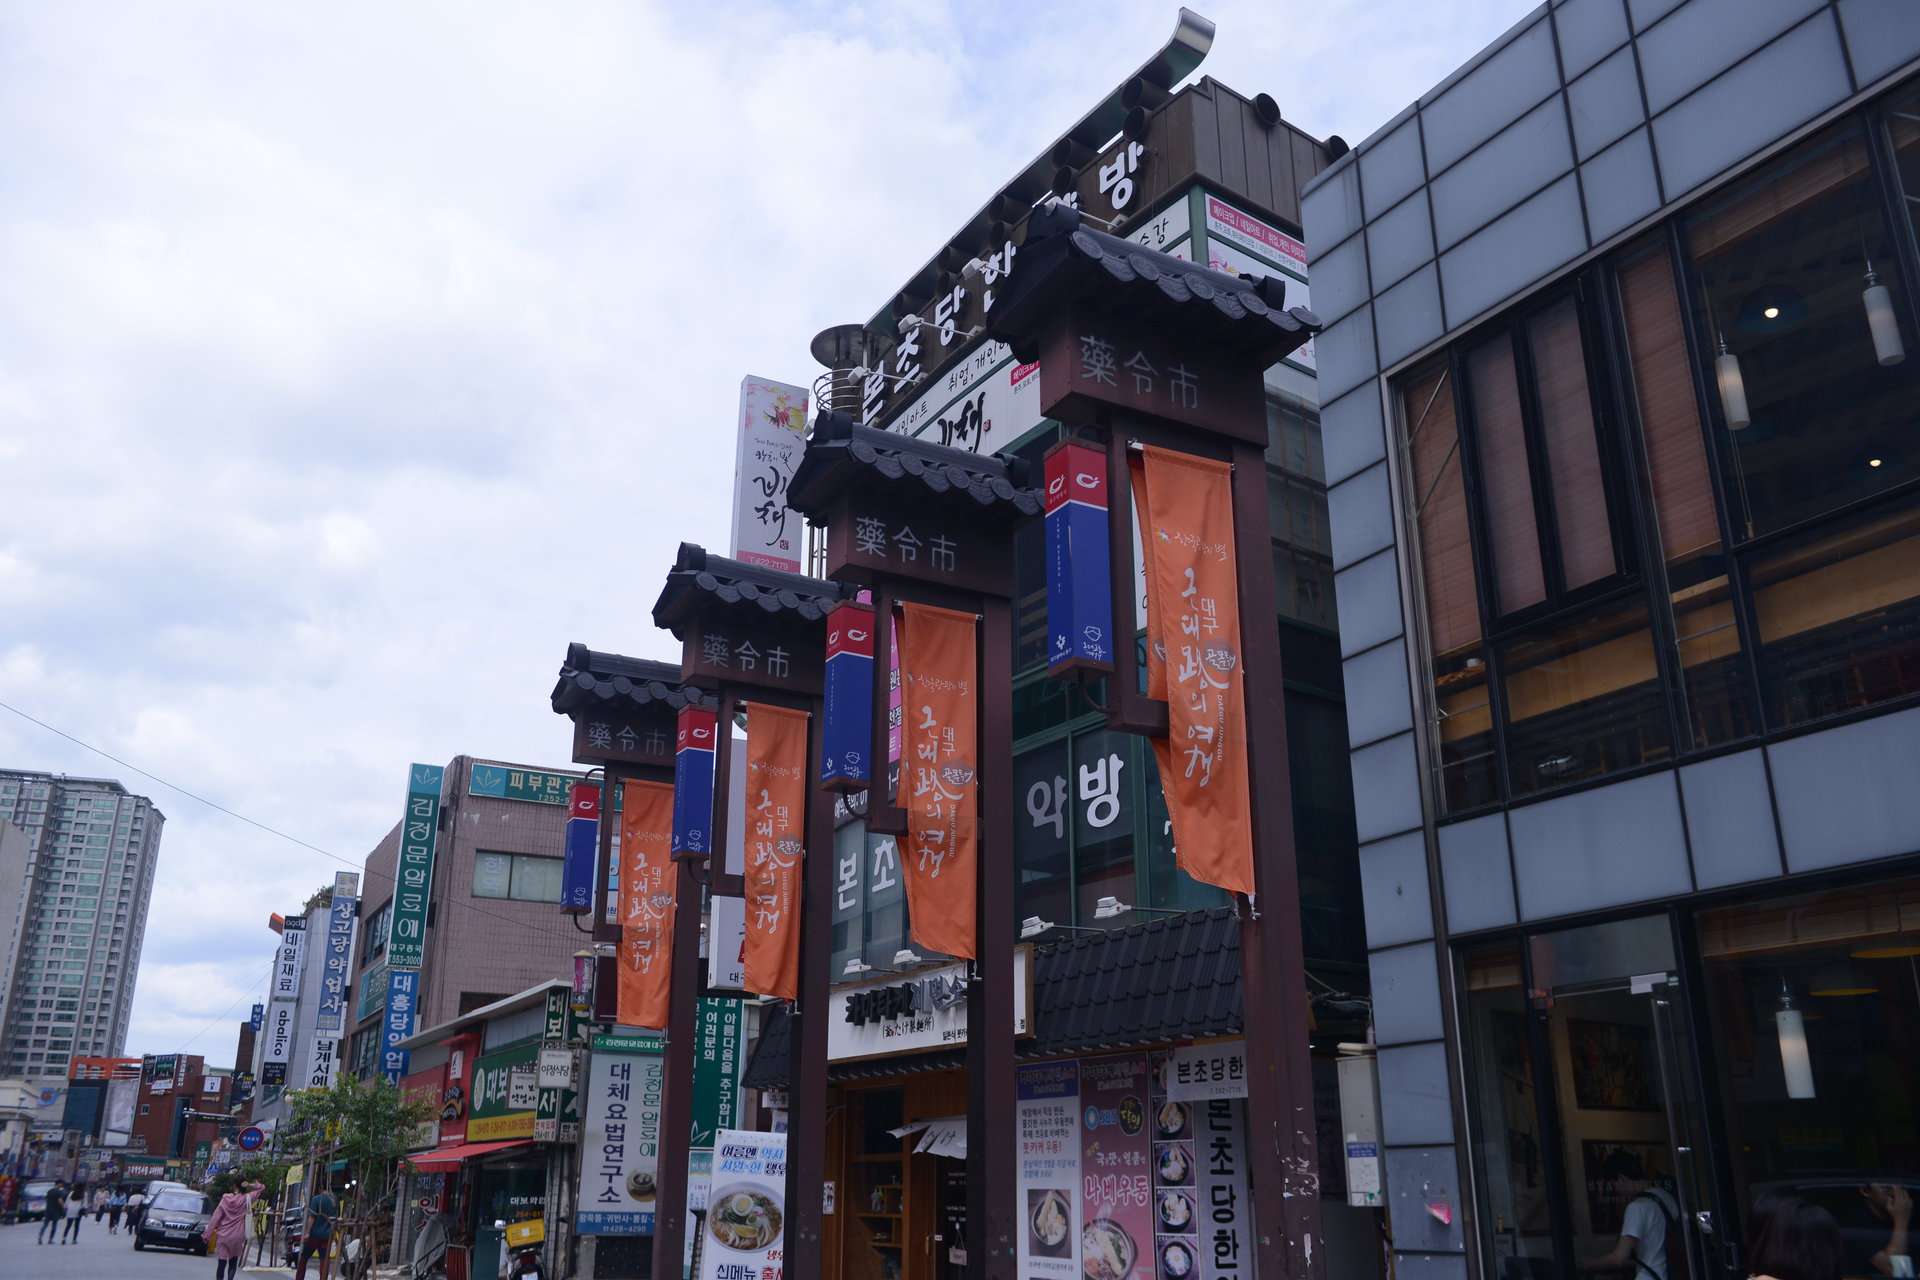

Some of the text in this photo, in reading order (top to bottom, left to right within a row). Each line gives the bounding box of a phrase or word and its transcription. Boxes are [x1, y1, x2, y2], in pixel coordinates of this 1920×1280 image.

[862, 141, 1145, 426] 본초당한방
[1080, 335, 1199, 409] 藥令市
[856, 516, 957, 572] 藥令市
[1201, 597, 1219, 635] 대구
[701, 636, 791, 679] 藥令市
[588, 721, 667, 756] 藥令市
[942, 726, 956, 757] 대구
[1216, 694, 1226, 762] DAEGU JUNGGU
[777, 805, 790, 832] 대구
[651, 866, 662, 889] 대구
[837, 839, 896, 911] 본초
[279, 932, 299, 993] 네일재료
[322, 902, 354, 1013] 상고당약업사
[274, 1009, 290, 1056] abalico
[704, 1012, 718, 1061] 여러분의
[541, 1064, 570, 1077] 이정식당
[718, 1013, 736, 1130] 아름다움을 추구합니
[1178, 1056, 1243, 1084] 본초당한
[597, 1062, 631, 1203] 대체요법연구소
[721, 1144, 784, 1160] 여름엔 역시
[1023, 1141, 1062, 1155] 붓카케 우동!
[1085, 1174, 1149, 1207] 나베우동
[717, 1264, 756, 1280] 신메뉴
